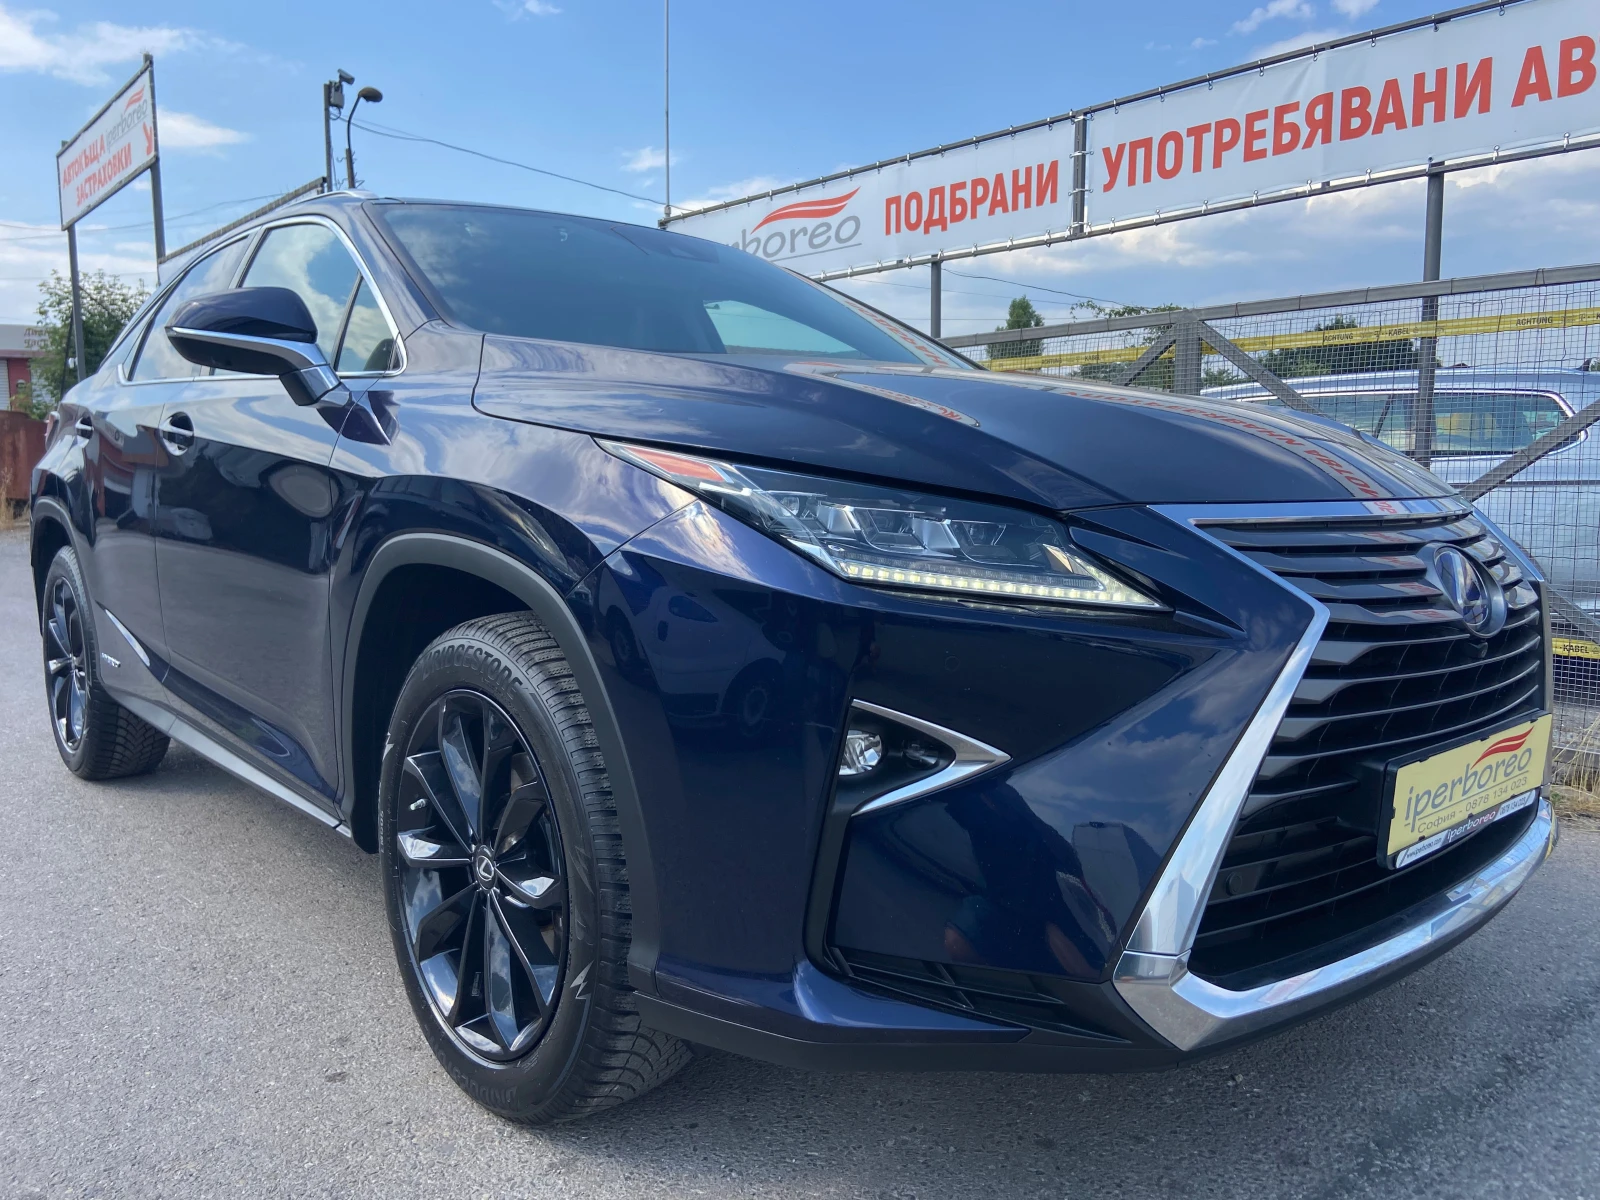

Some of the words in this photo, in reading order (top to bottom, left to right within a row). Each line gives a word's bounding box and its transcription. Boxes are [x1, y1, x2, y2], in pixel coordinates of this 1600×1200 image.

[1102, 57, 1493, 193] УПОТРЕБЯВАНИ
[1511, 35, 1600, 107] АВ
[62, 134, 106, 189] АВТОКЪЩА
[76, 142, 132, 207] ЗАСТРАХОВКИ
[885, 160, 1059, 235] ПОДБРАНИ
[1323, 332, 1354, 342] ACHTUNG
[1388, 327, 1411, 336] KABEL
[1515, 316, 1554, 326] ACHTUNG
[422, 643, 524, 700] BRIDGESTONE
[1563, 644, 1590, 654] KABEL
[1405, 748, 1532, 832] iperboreo
[1418, 811, 1456, 834] София
[1465, 793, 1490, 812] 0878
[1493, 785, 1508, 800] 134
[1510, 776, 1528, 791] 023
[1446, 810, 1496, 843] iperboreo
